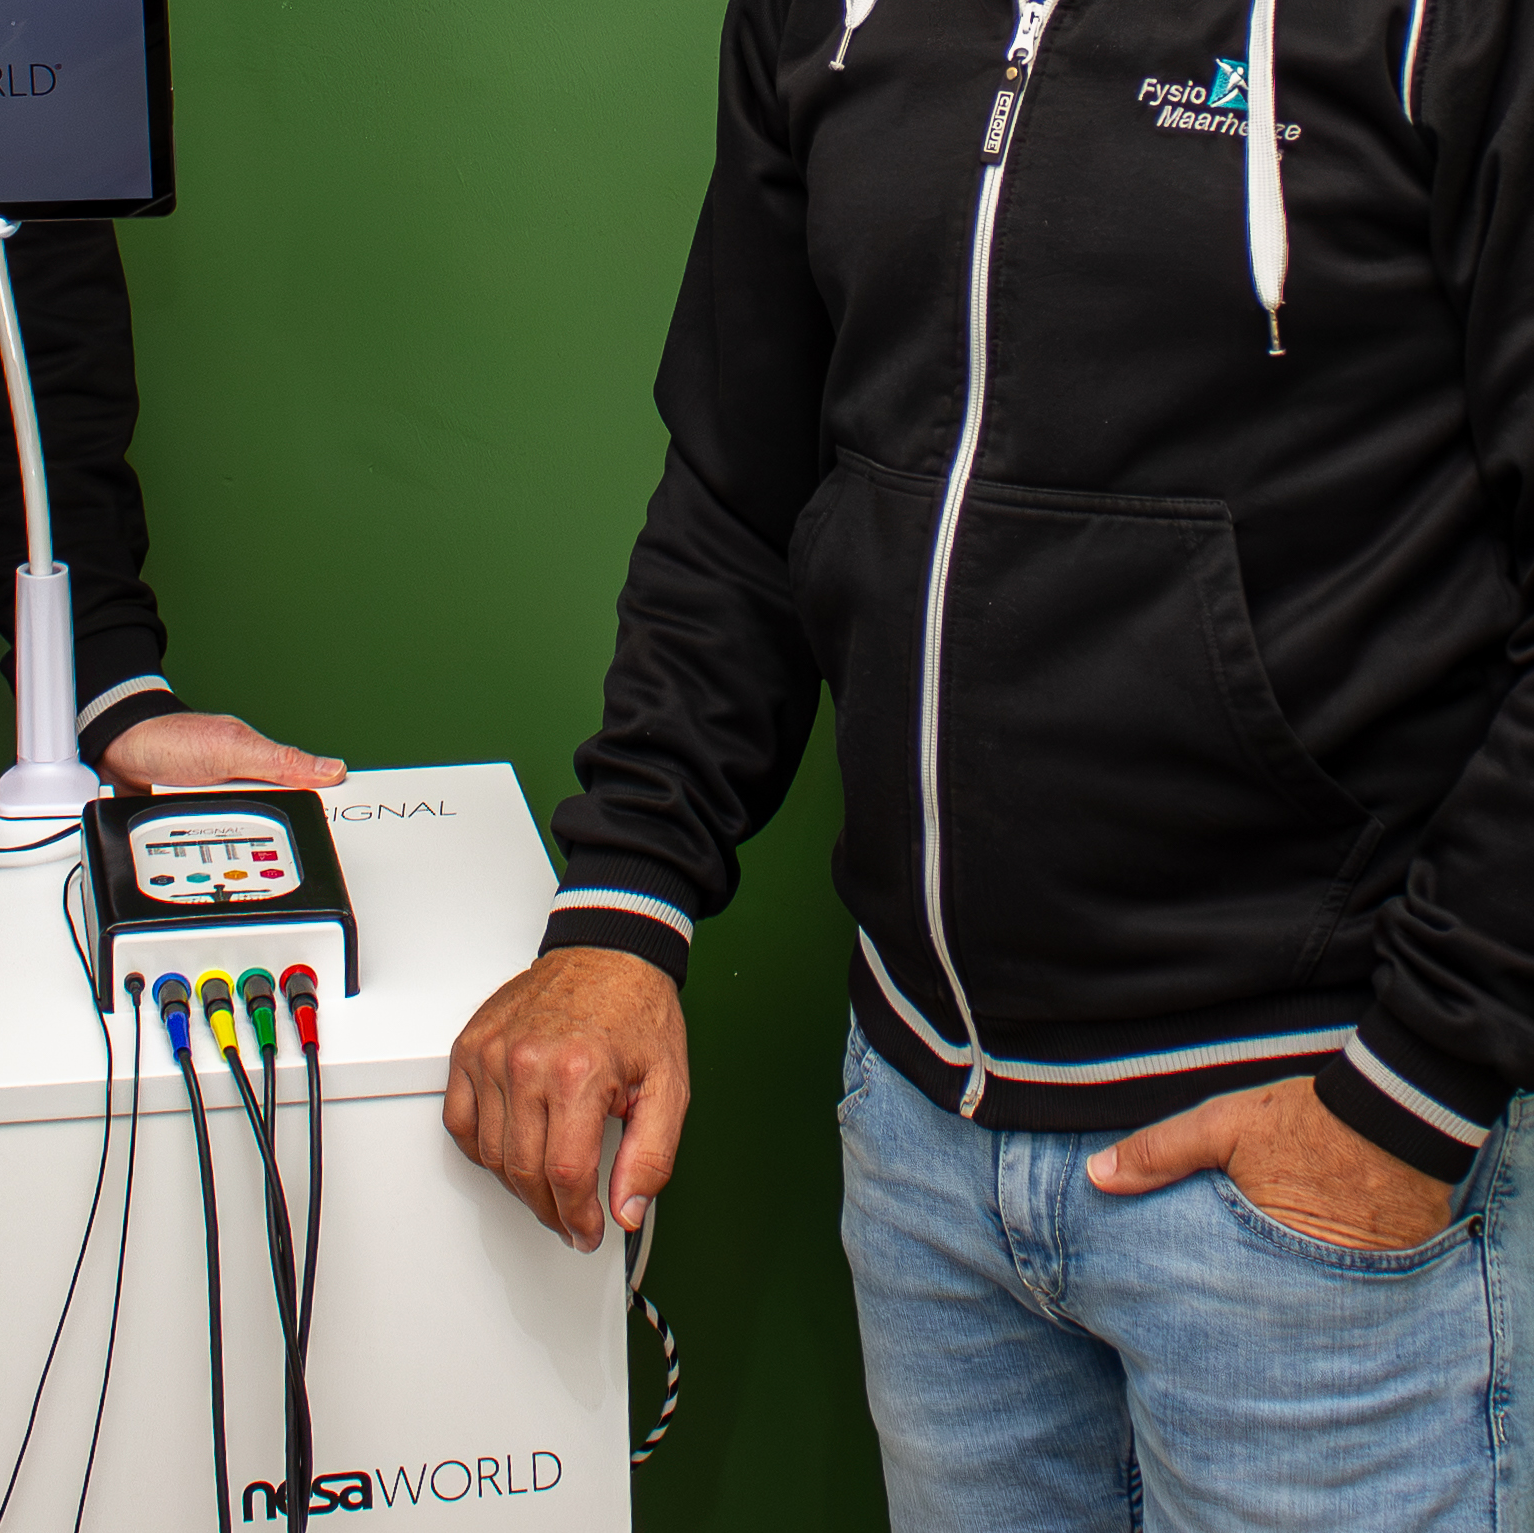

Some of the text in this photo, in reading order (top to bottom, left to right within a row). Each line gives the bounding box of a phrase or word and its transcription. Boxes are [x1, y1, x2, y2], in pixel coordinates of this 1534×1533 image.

[1137, 77, 1207, 107] Fysio
[986, 94, 1011, 152] CLIQUE
[1155, 105, 1302, 141] Maarheze
[324, 799, 458, 823] IGNAL
